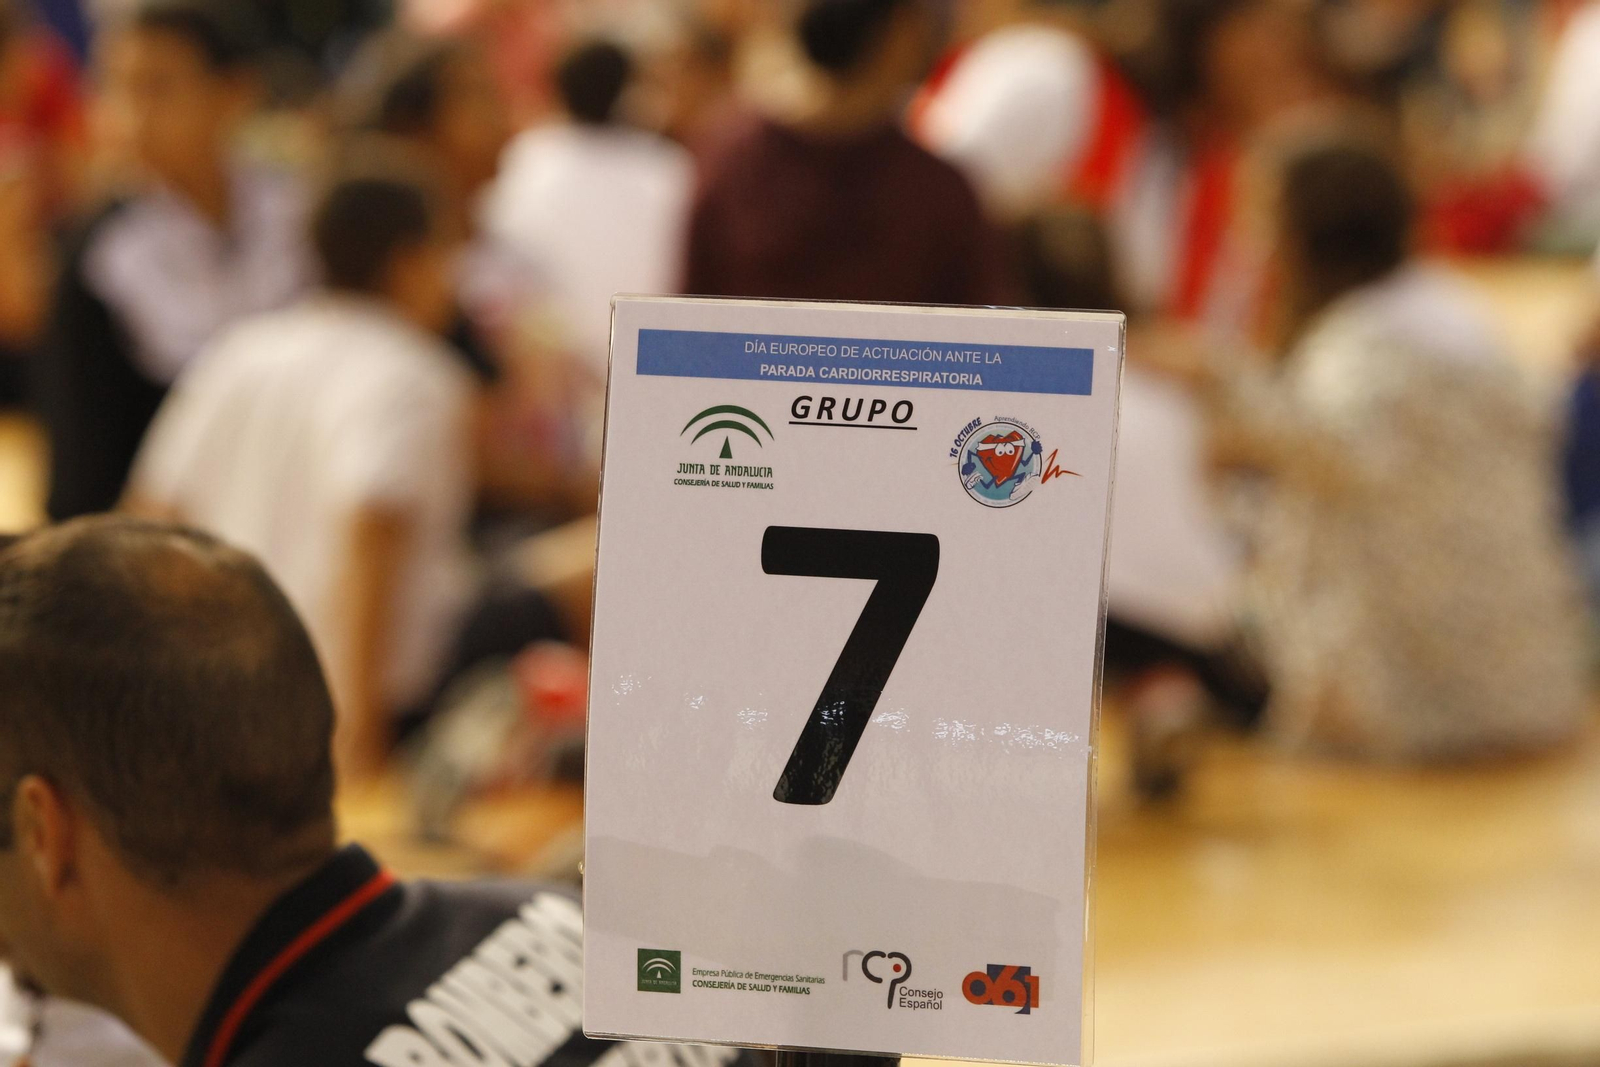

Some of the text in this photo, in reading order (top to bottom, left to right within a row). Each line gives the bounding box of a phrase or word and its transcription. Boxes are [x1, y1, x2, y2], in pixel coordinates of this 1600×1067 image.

[744, 339, 1002, 364] DÍA EUROPEO DE ACTUACIÓN ANTE LA
[760, 364, 983, 385] PARADA CARDIORRESPIRATORIA
[791, 395, 915, 425] GRUPO
[949, 416, 982, 458] 16 OCTUBRE
[677, 463, 705, 474] JUNTA
[710, 464, 720, 475] DE
[673, 479, 710, 487] CONSEJERÍA
[721, 480, 740, 488] SALUD
[746, 481, 774, 490] FAMILIAS
[761, 526, 939, 805] 7
[692, 967, 826, 984] Empresa Pública de Emergencias Sanitarias
[692, 979, 811, 995] CONSEJERÍA DE SALUD Y FAMILIAS
[899, 986, 944, 999] Consejo
[962, 965, 1040, 1009] 061
[899, 997, 943, 1011] Español
